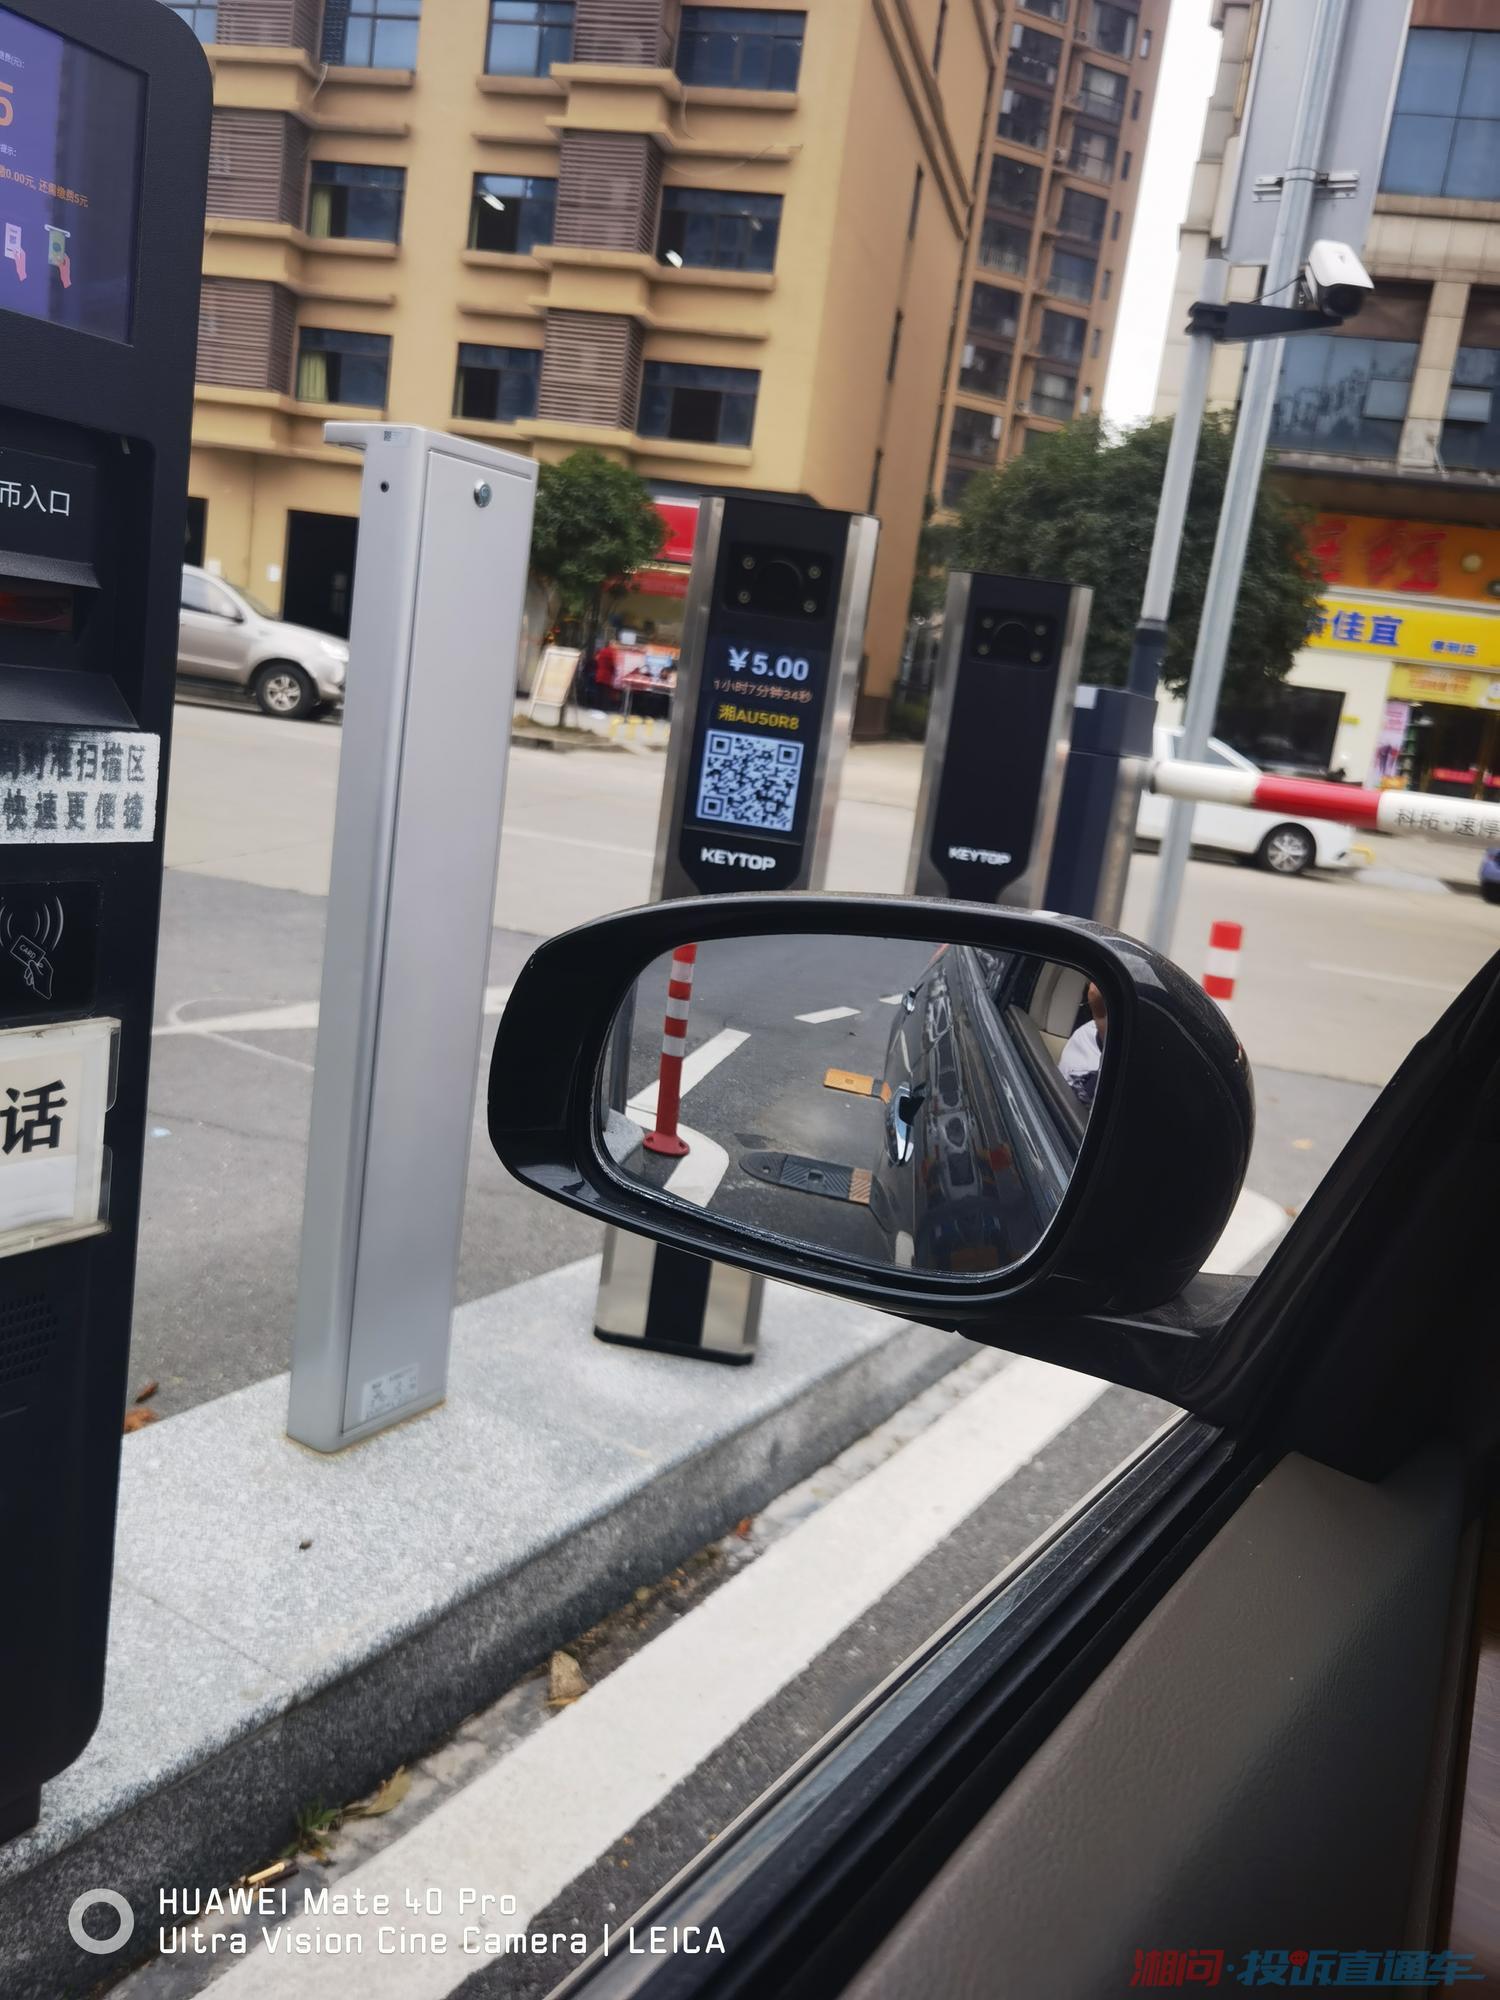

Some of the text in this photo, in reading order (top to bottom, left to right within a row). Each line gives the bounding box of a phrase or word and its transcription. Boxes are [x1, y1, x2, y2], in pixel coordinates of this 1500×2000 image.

[0, 479, 71, 517] 币入口
[713, 678, 813, 704] 1小时7分钟34秒
[701, 847, 776, 871] KEYTOP
[948, 846, 1012, 866] KEYTOP
[0, 1079, 69, 1156] 话
